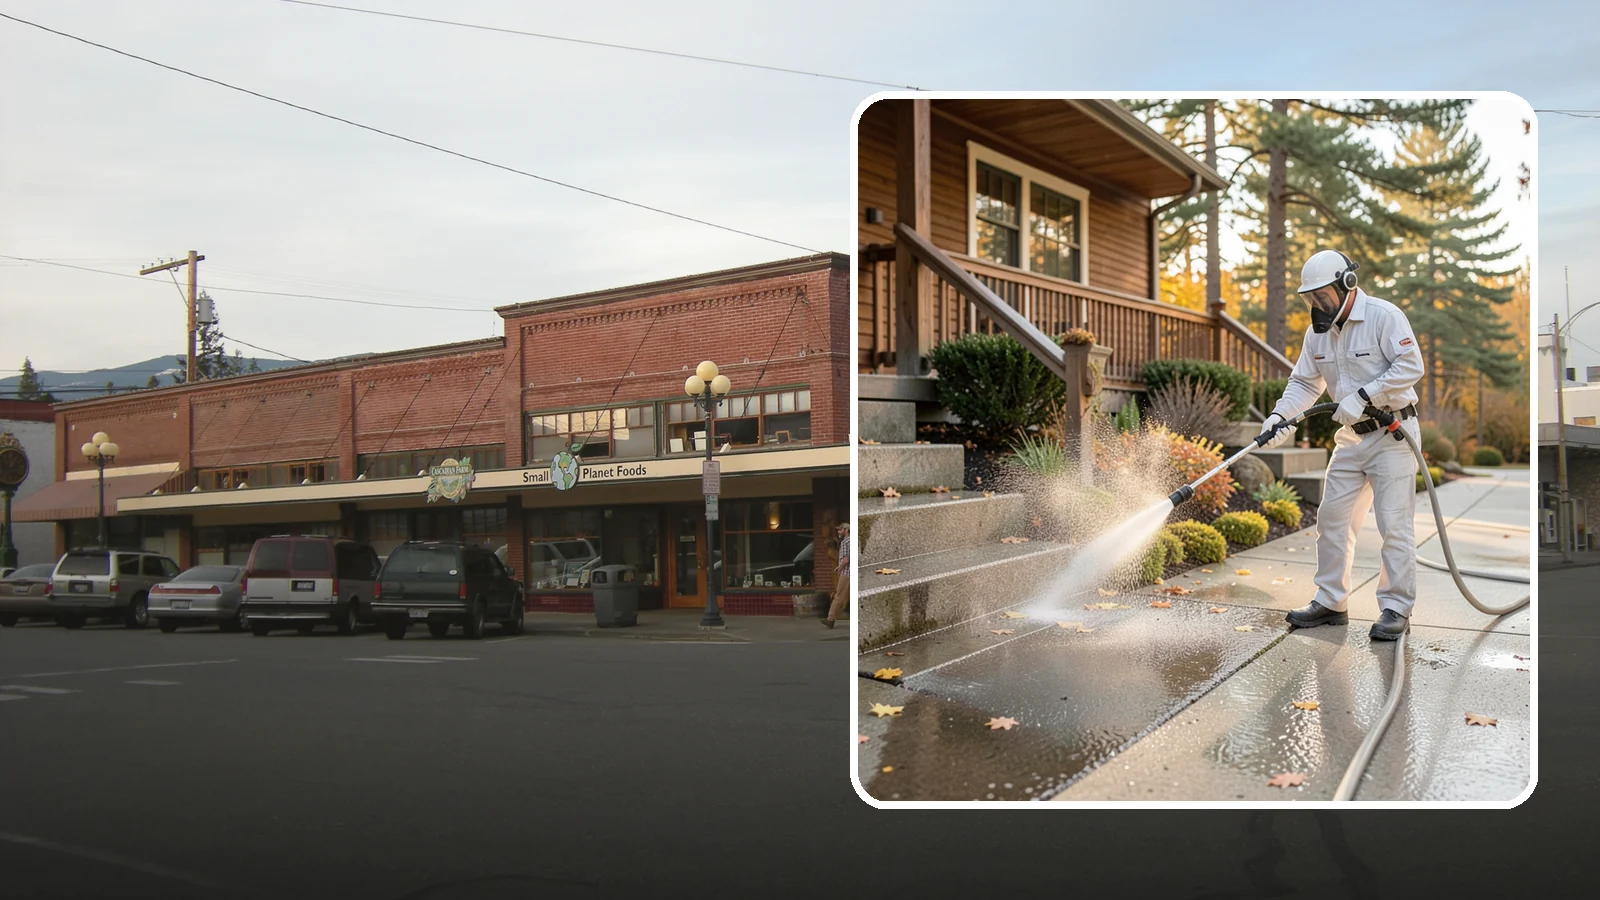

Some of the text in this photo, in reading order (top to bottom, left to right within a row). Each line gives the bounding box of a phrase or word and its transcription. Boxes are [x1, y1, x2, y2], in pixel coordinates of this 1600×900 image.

[523, 464, 647, 483] Small Planet Foods
